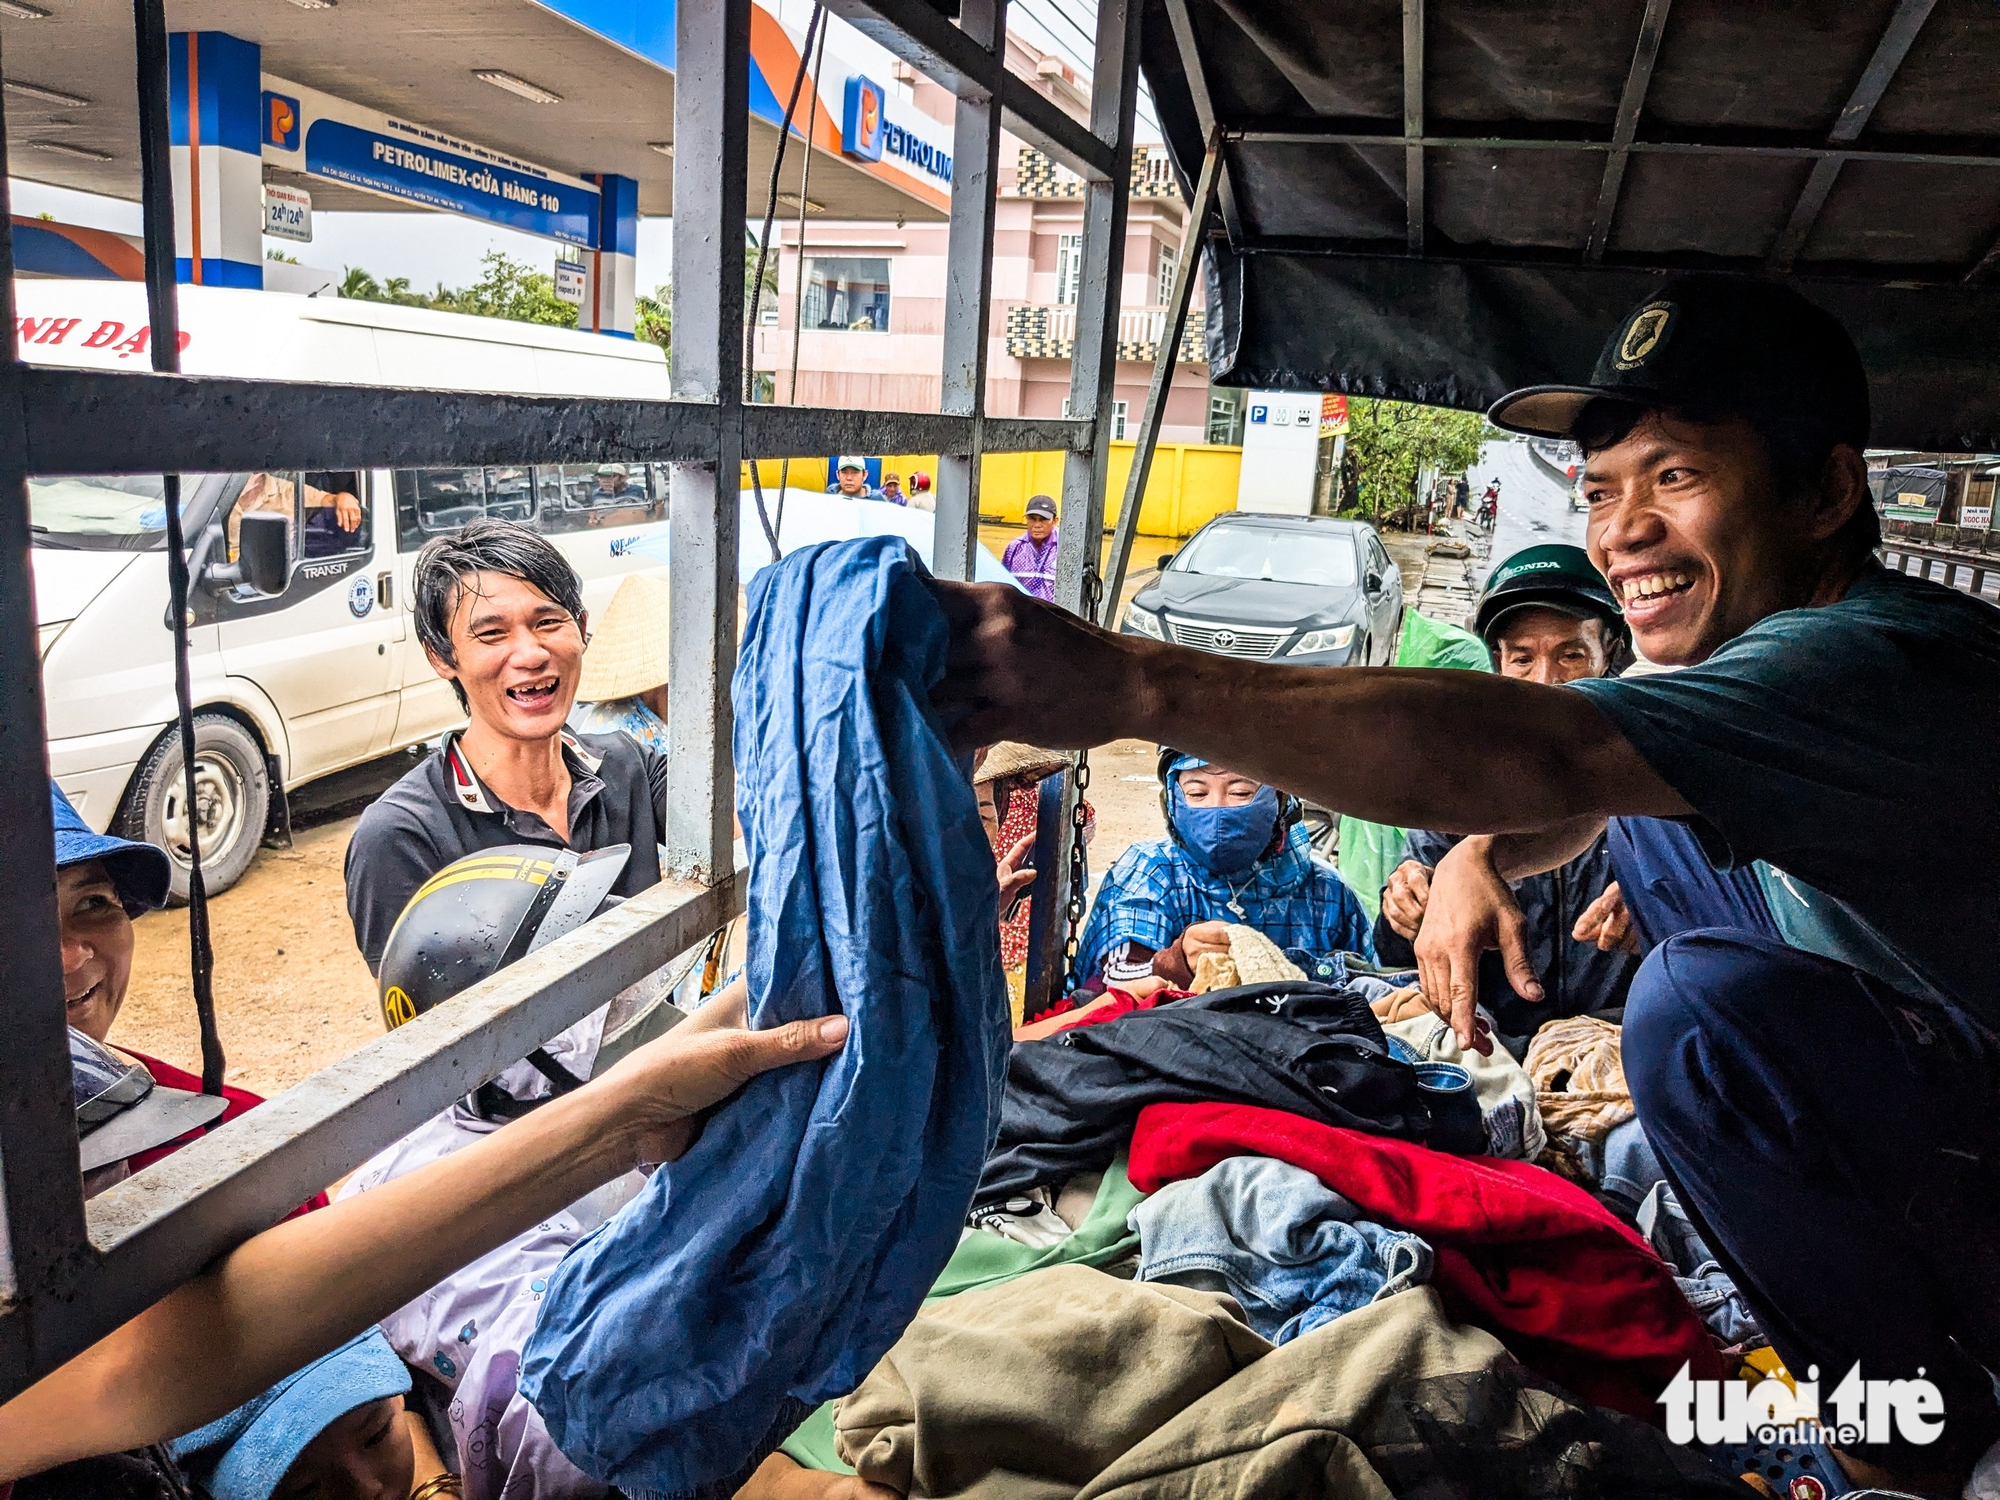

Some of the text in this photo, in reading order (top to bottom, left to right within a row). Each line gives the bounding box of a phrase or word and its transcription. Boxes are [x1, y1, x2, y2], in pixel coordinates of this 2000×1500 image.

[502, 180, 538, 207] HÀNG
[540, 193, 560, 213] 110
[1254, 408, 1264, 421] P
[303, 562, 348, 579] TRANSIT
